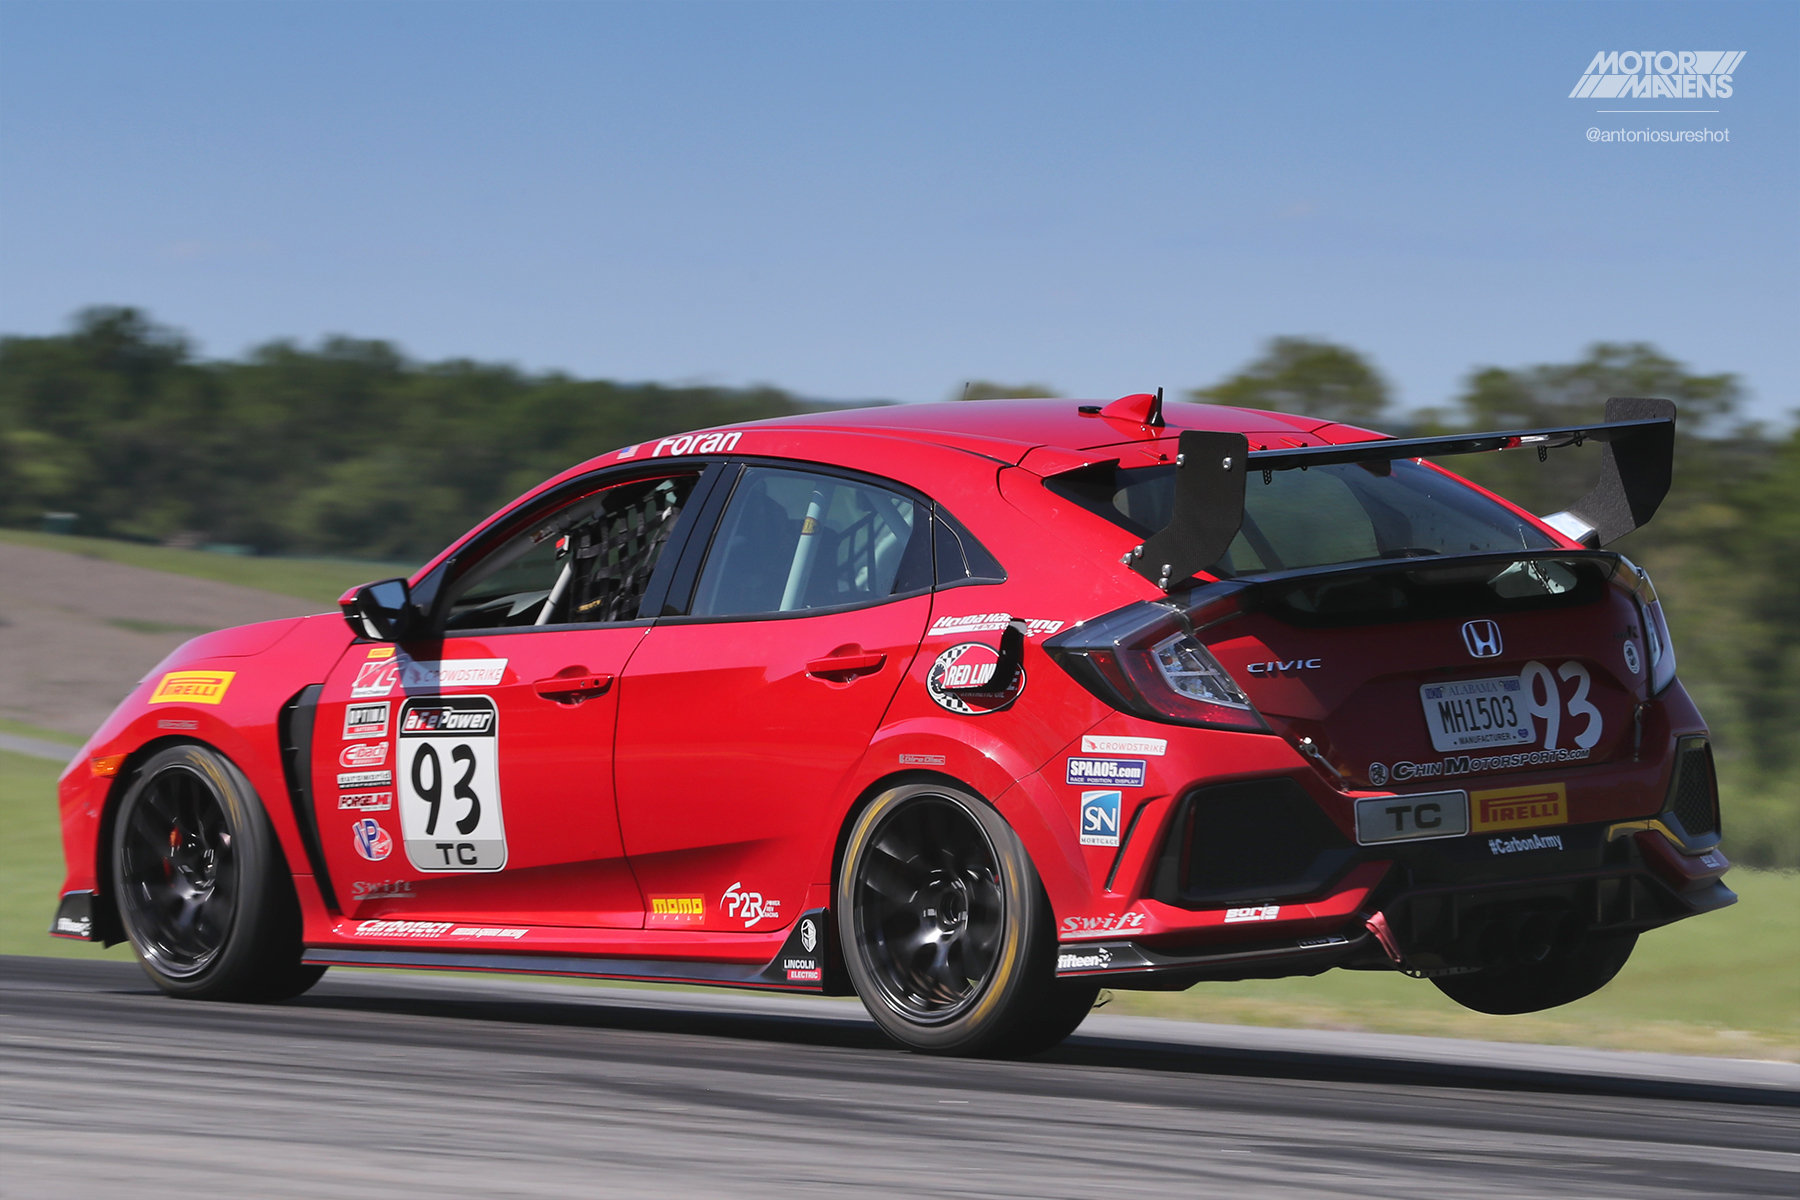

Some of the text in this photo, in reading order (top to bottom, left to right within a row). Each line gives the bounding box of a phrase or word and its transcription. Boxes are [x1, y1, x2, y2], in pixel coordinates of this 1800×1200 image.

[652, 431, 743, 457] Foran
[933, 615, 988, 628] Honda
[424, 668, 503, 682] CROWDSTRIKE
[945, 664, 972, 686] RED
[1246, 658, 1322, 674] CIVIC
[158, 677, 224, 697] PIRELLI
[1449, 682, 1499, 696] ALABAMA
[1437, 695, 1518, 734] MH1503
[1519, 660, 1604, 750] 93
[1099, 741, 1165, 753] CROWDSTRIKE
[1458, 732, 1511, 745] MANUFACTURER
[1070, 760, 1142, 779] SPAA05.com
[410, 742, 481, 835] 93
[1386, 803, 1442, 832] TC
[1480, 792, 1560, 823] PIRELLI
[1084, 806, 1117, 832] SN
[1081, 837, 1119, 845] MORTGAGE
[1489, 833, 1564, 855] #CarbonArmy
[435, 843, 478, 865] TC
[784, 959, 815, 969] LINCOLN
[790, 971, 819, 979] ELECTRIC
